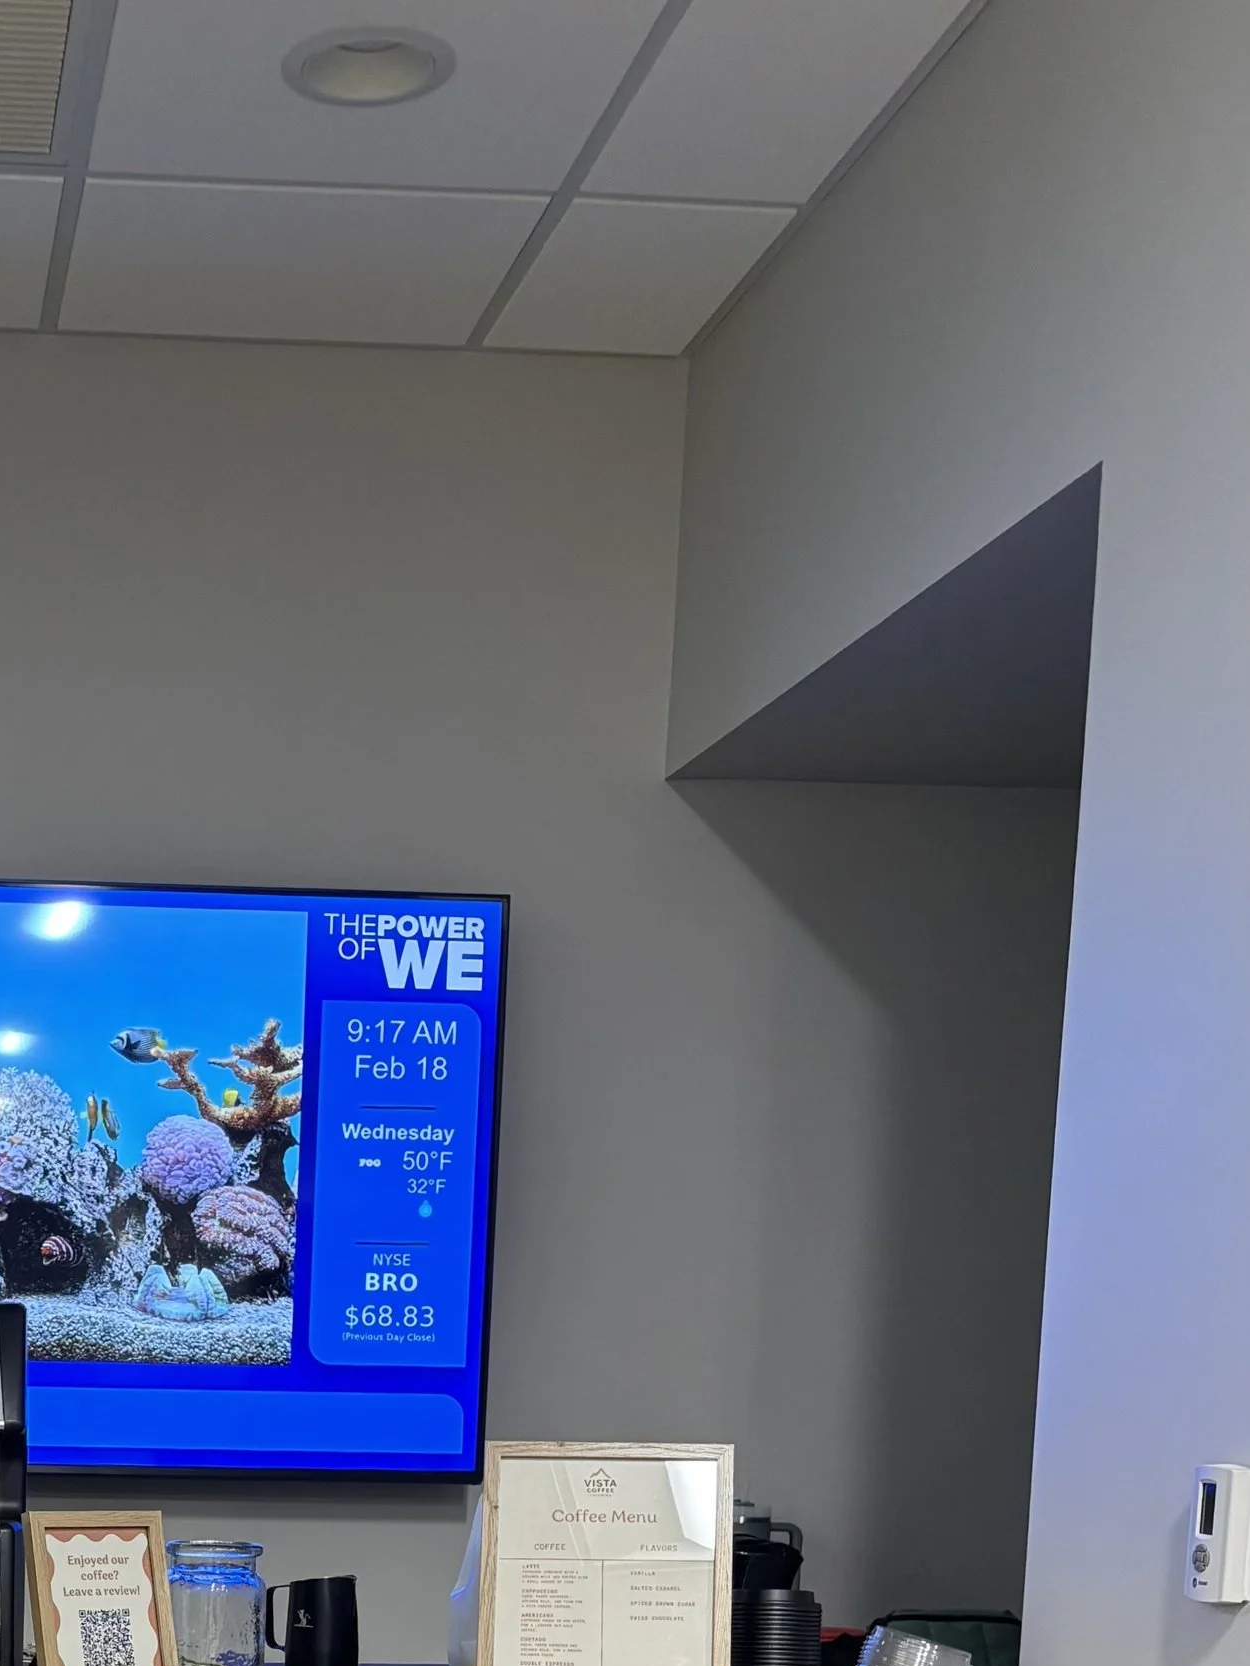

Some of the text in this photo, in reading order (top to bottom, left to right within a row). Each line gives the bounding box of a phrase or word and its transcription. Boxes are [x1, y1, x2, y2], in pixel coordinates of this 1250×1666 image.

[323, 912, 485, 939] THE POWER
[338, 937, 485, 992] OF WE
[347, 1018, 458, 1045] 9:17 AM
[355, 1054, 448, 1081] Feb 18
[341, 1122, 455, 1146] Wednesday
[402, 1151, 453, 1171] 50°F
[407, 1178, 447, 1195] 32°F
[373, 1253, 411, 1267] NYSE
[365, 1272, 419, 1292] BRO
[344, 1304, 434, 1330] $68.83
[342, 1331, 436, 1344] (Previous Day Close)
[584, 1479, 617, 1488] VISTA
[552, 1509, 657, 1523] Coffee Menu
[534, 1543, 566, 1551] COFFEE
[640, 1544, 678, 1552] FLAVORS
[67, 1555, 129, 1568] Enjoyed our
[81, 1569, 119, 1580] coffee?
[63, 1585, 141, 1597] Leave a review!
